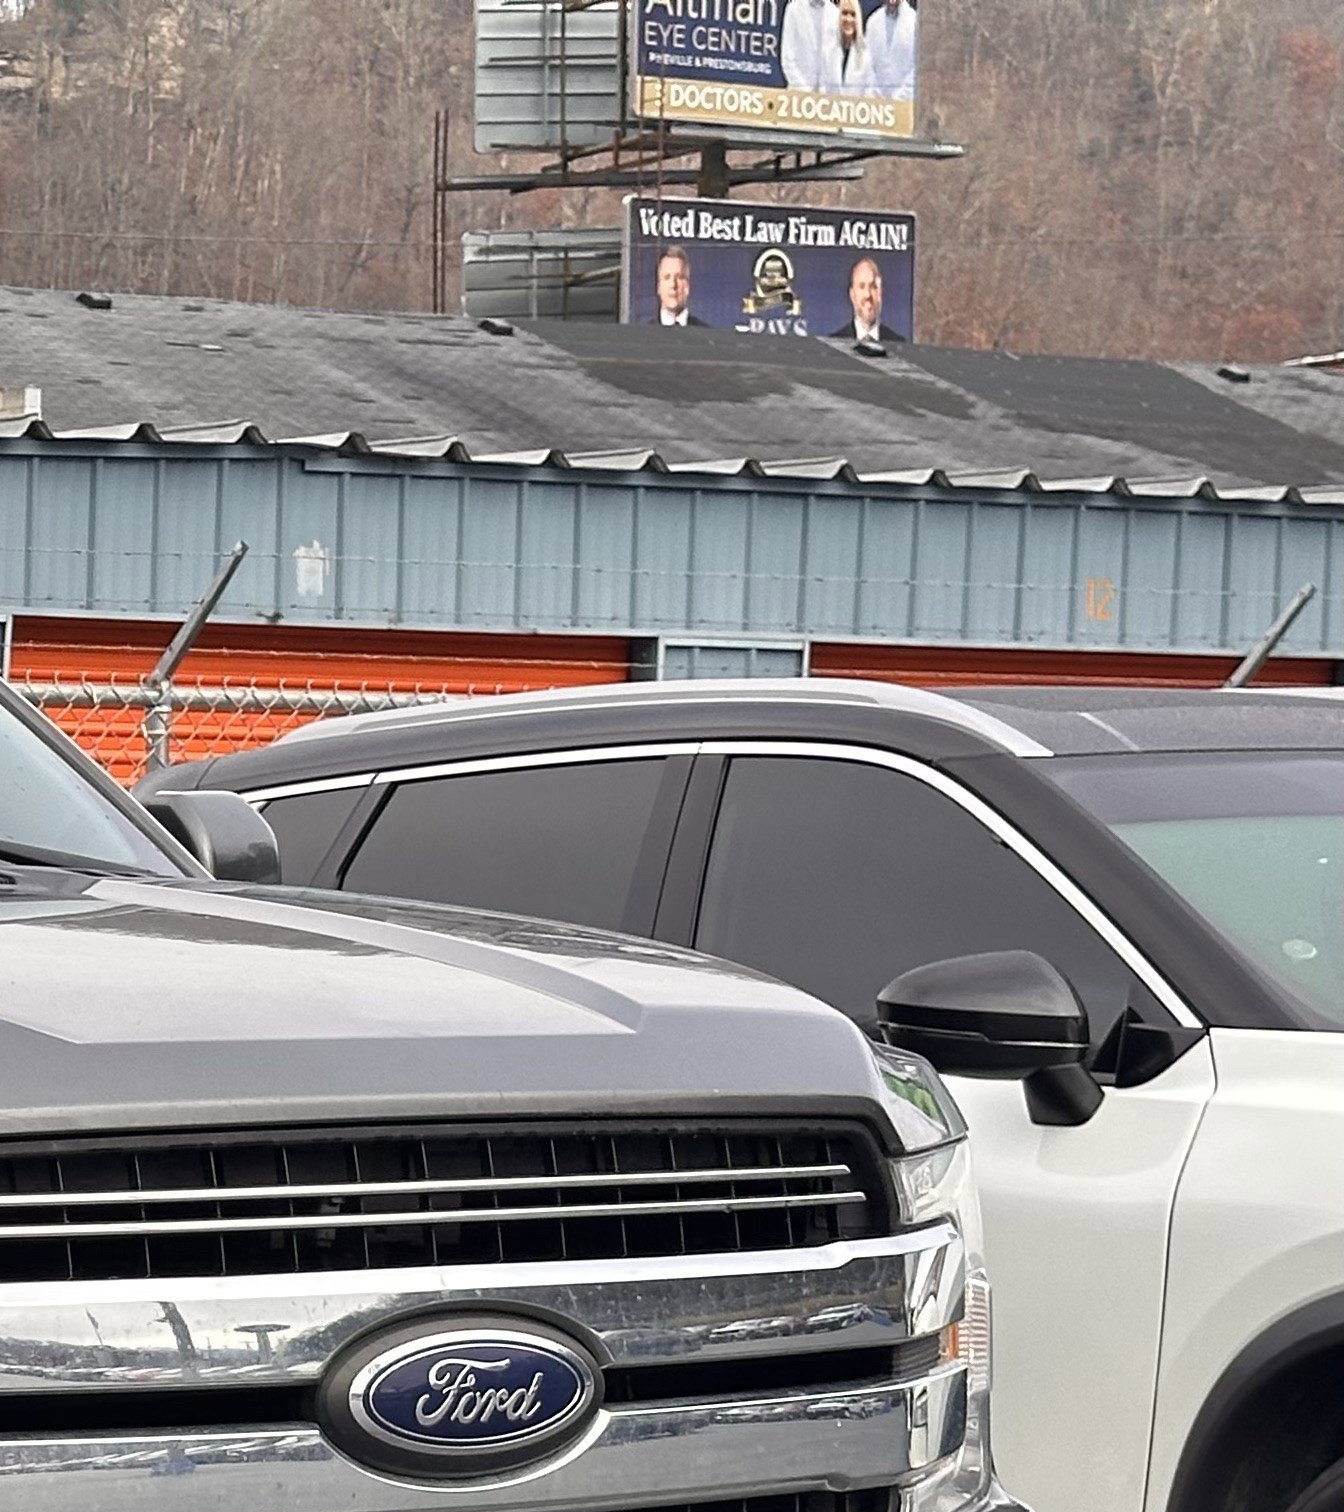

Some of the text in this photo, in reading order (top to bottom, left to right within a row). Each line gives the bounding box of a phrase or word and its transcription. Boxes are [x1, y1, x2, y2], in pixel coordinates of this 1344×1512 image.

[644, 21, 778, 58] EYE CENTER
[669, 84, 764, 115] DOCTORS
[776, 95, 789, 117] 2
[791, 95, 896, 127] LOCATIONS
[639, 208, 909, 251] Voted Best Law Firm AGAIN!
[1086, 576, 1116, 621] 12
[415, 1357, 544, 1427] Ford
